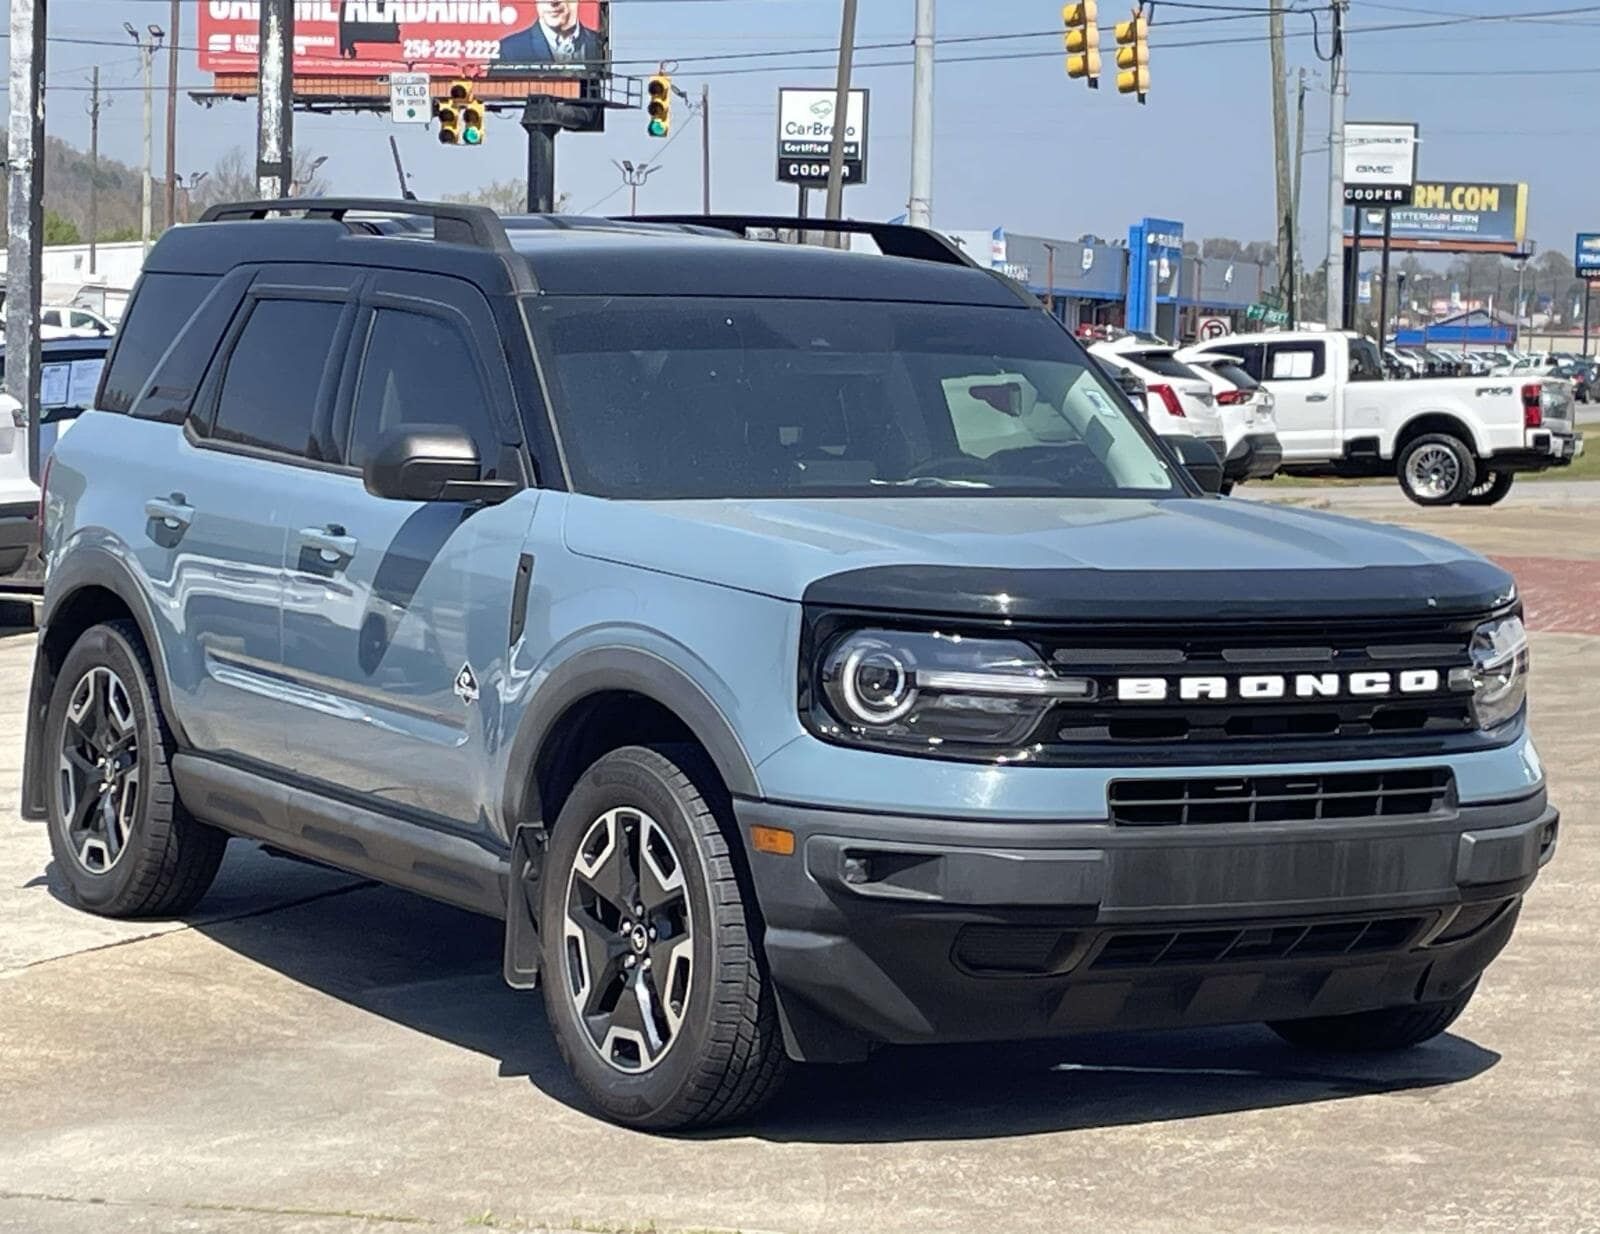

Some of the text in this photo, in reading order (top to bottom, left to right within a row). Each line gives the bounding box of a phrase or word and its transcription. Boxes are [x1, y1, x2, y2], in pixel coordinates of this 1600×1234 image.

[395, 85, 427, 97] YIELD
[784, 142, 829, 154] Certified
[789, 163, 850, 177] COOPR
[1355, 165, 1395, 174] GMC
[1343, 188, 1403, 201] COOPER
[1117, 669, 1439, 701] BRONCO
